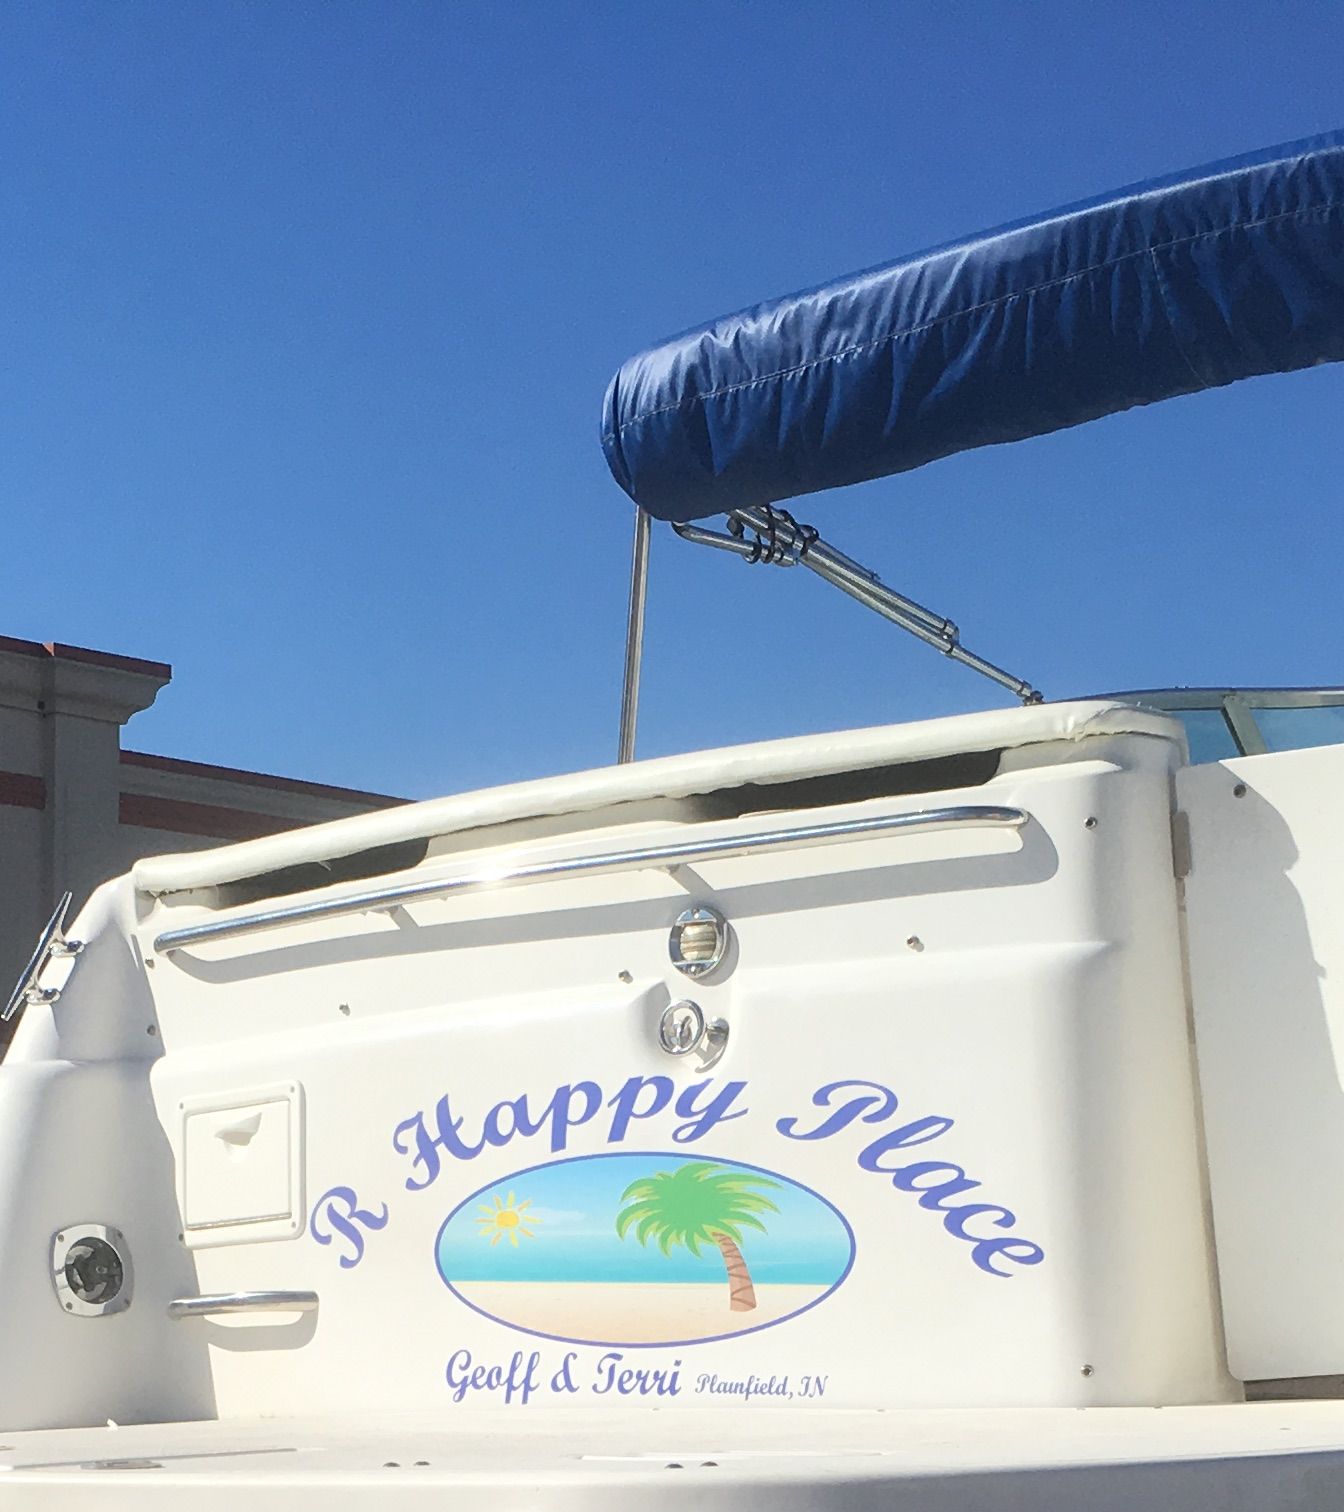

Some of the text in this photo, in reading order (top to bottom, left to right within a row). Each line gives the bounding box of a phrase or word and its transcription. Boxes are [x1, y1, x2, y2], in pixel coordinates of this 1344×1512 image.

[310, 1074, 1045, 1278] R Happy Place
[445, 1349, 541, 1405] Geoff
[550, 1352, 580, 1394] &
[591, 1352, 683, 1397] Terri
[798, 1375, 829, 1398] IN
